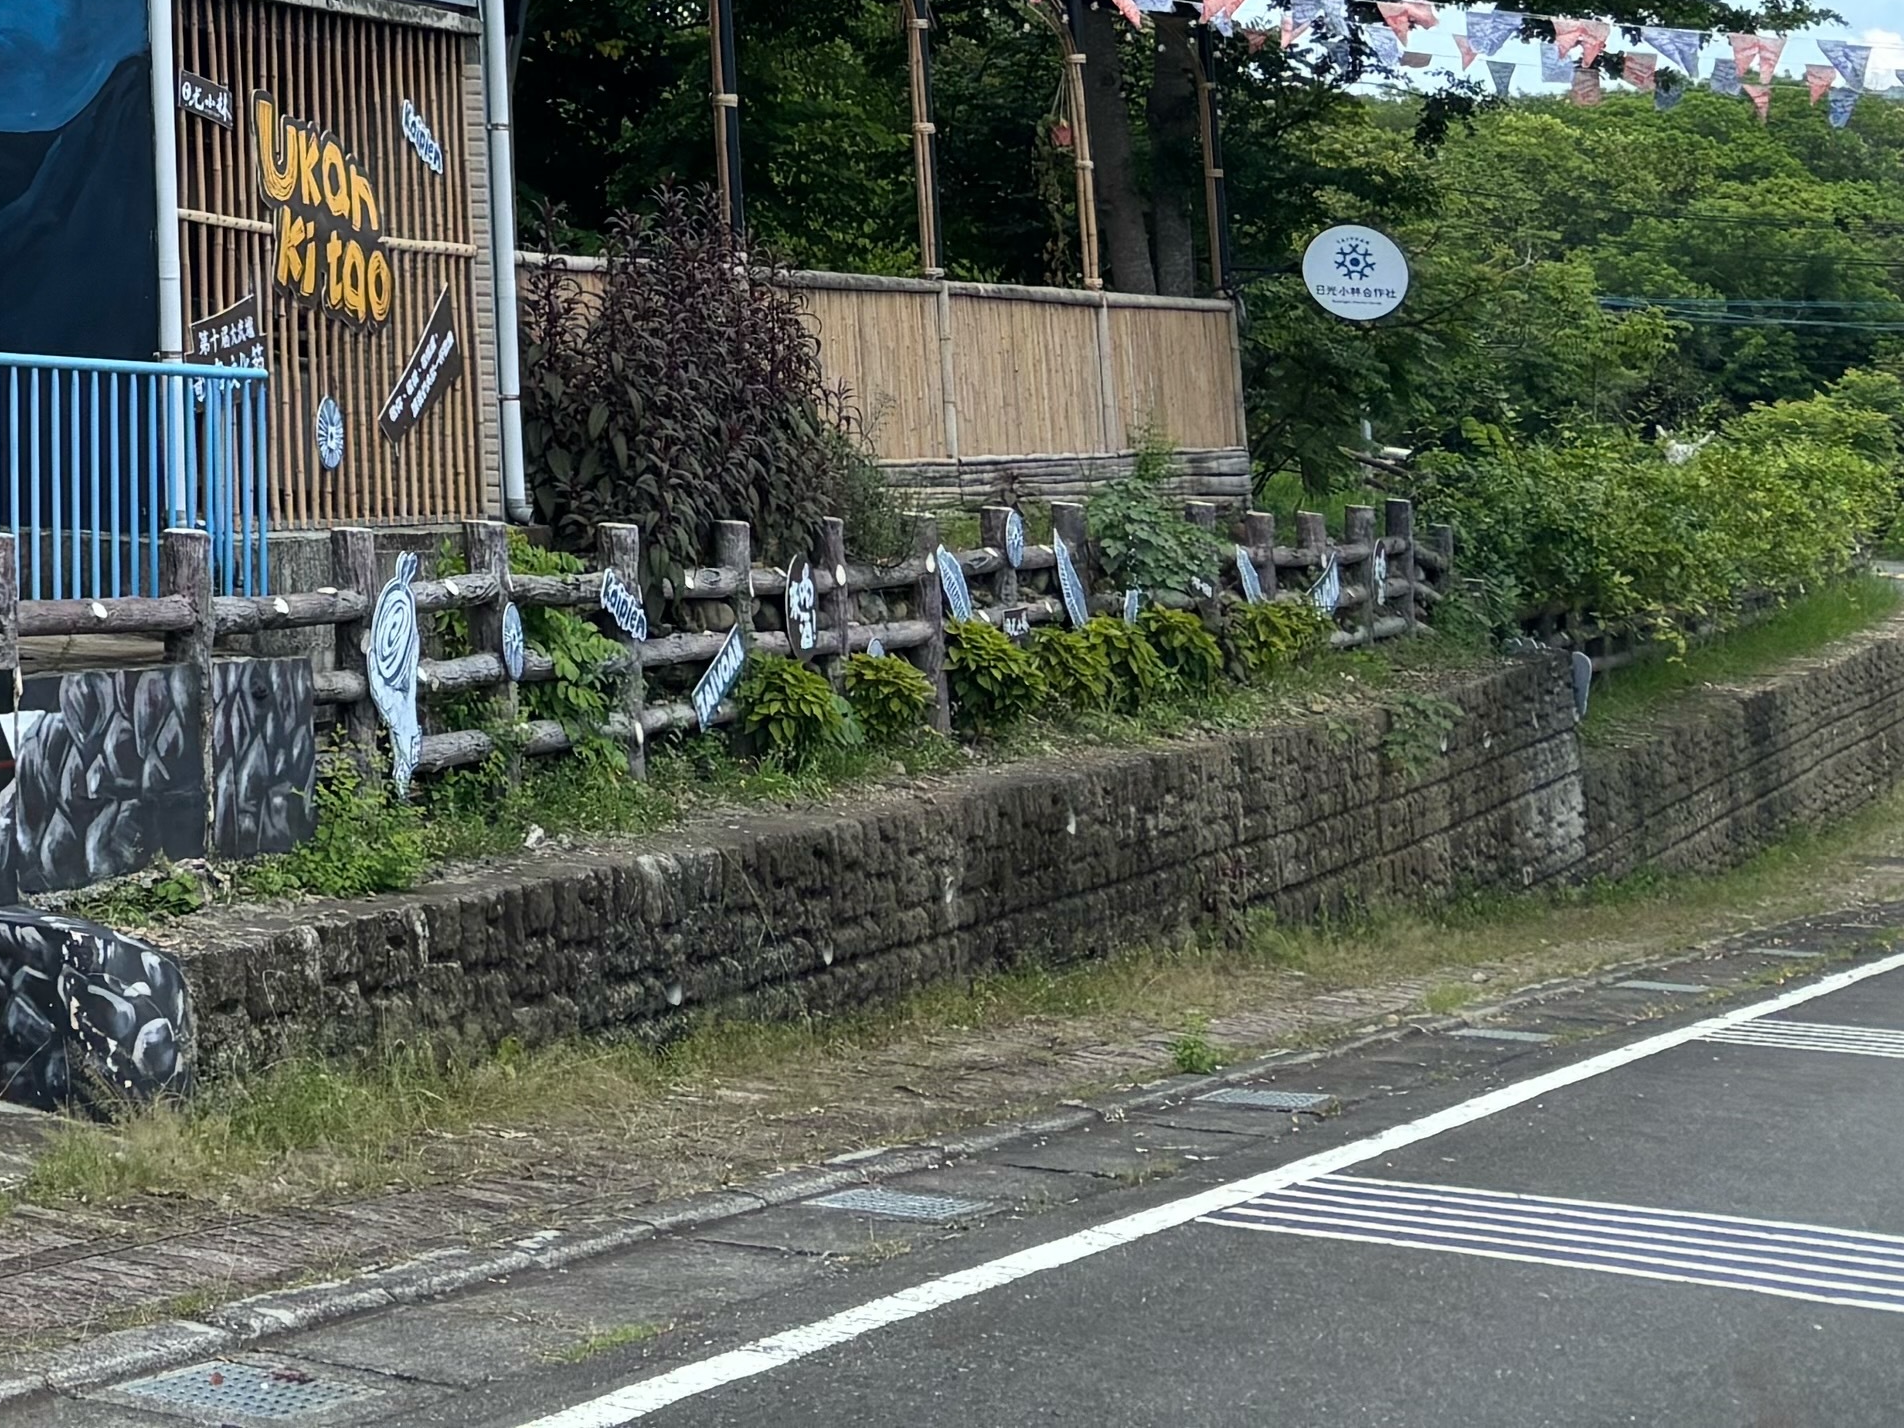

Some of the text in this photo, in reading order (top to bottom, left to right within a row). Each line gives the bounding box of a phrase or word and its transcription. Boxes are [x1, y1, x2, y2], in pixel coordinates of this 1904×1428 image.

[1316, 284, 1397, 299] 日光小林合作社
[696, 633, 744, 724] TAIVOAN
